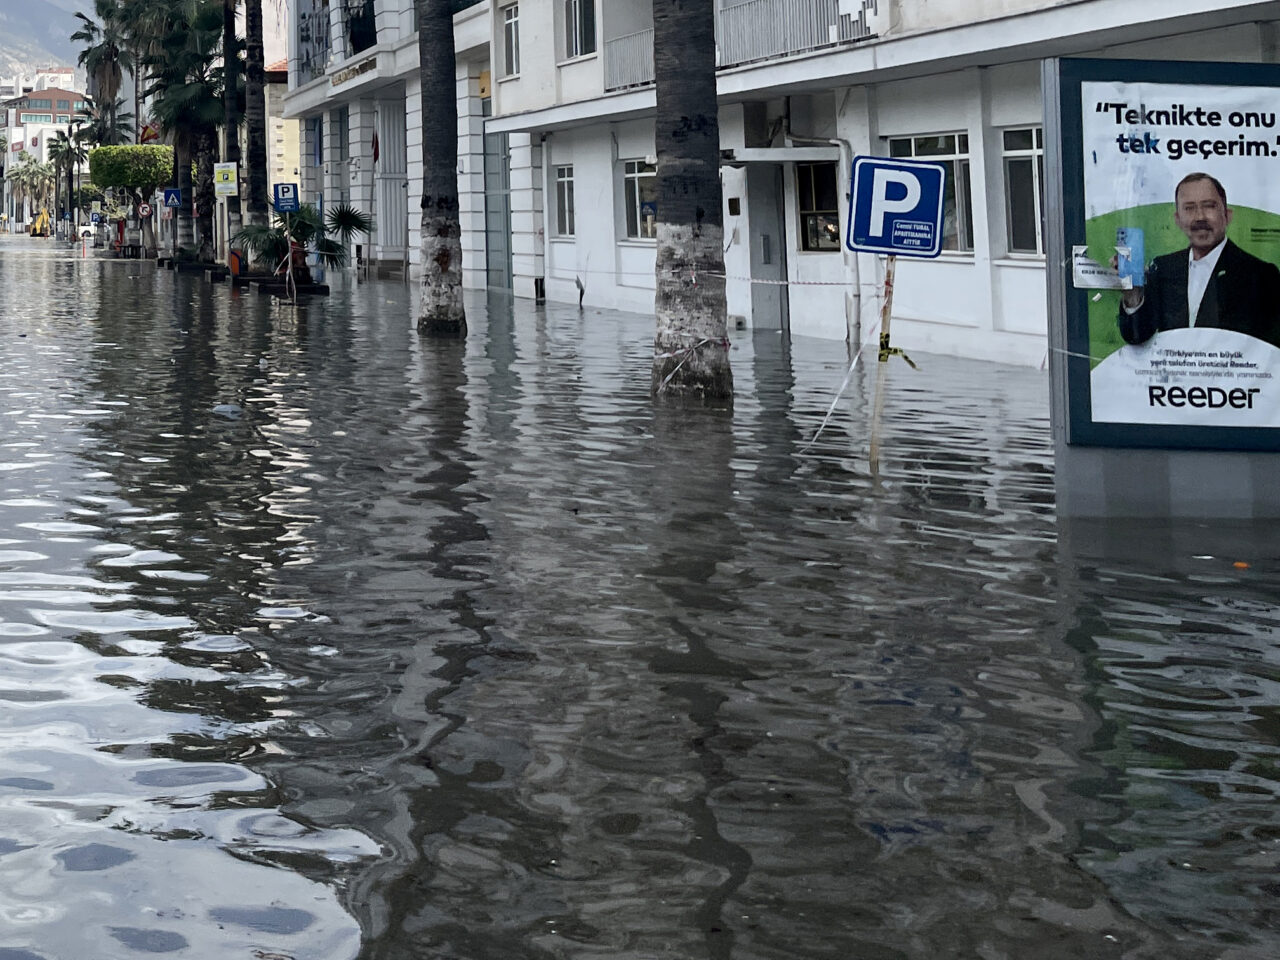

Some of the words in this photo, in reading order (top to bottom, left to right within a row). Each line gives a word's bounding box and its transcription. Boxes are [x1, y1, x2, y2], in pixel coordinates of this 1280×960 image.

[1229, 112, 1275, 128] onu
[1116, 132, 1161, 154] tek
[281, 186, 290, 197] P
[869, 168, 922, 238] P
